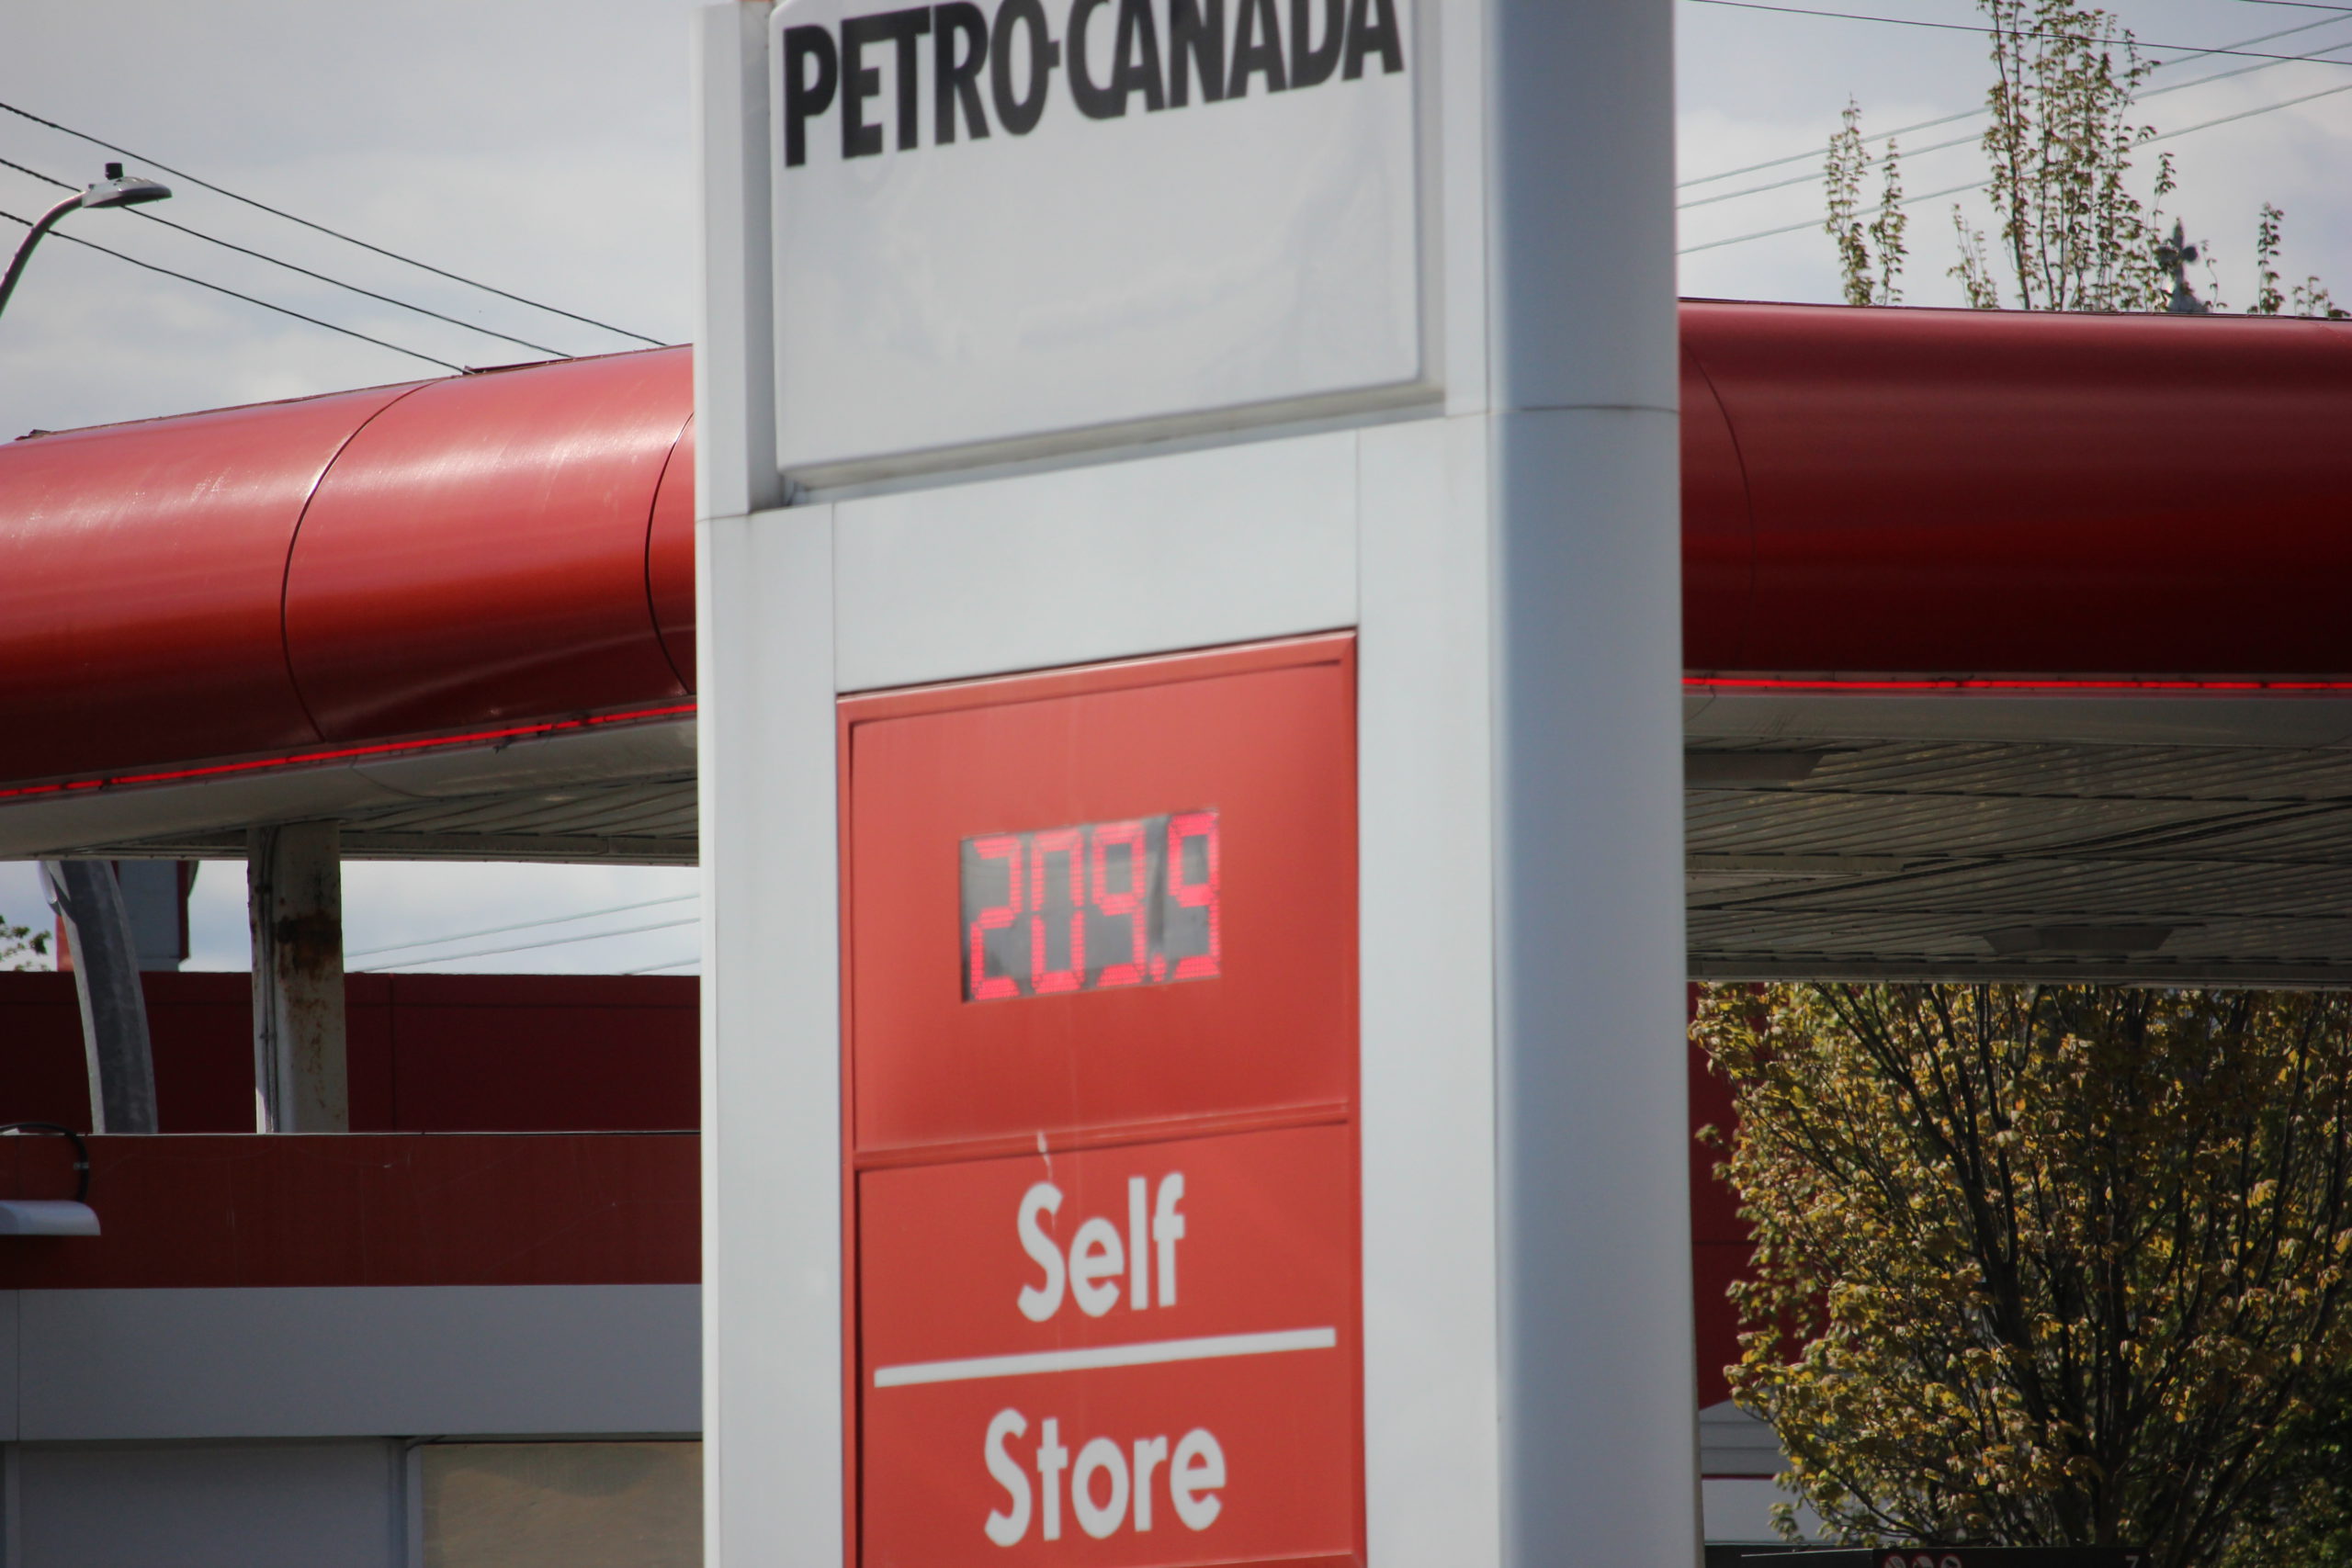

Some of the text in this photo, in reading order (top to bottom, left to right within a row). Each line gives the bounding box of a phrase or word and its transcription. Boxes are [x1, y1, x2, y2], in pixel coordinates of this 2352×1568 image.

[784, 0, 1404, 168] PETRO-CANADA
[970, 812, 1220, 1000] 209.9
[1017, 1171, 1185, 1323] Self
[984, 1407, 1227, 1547] Store
